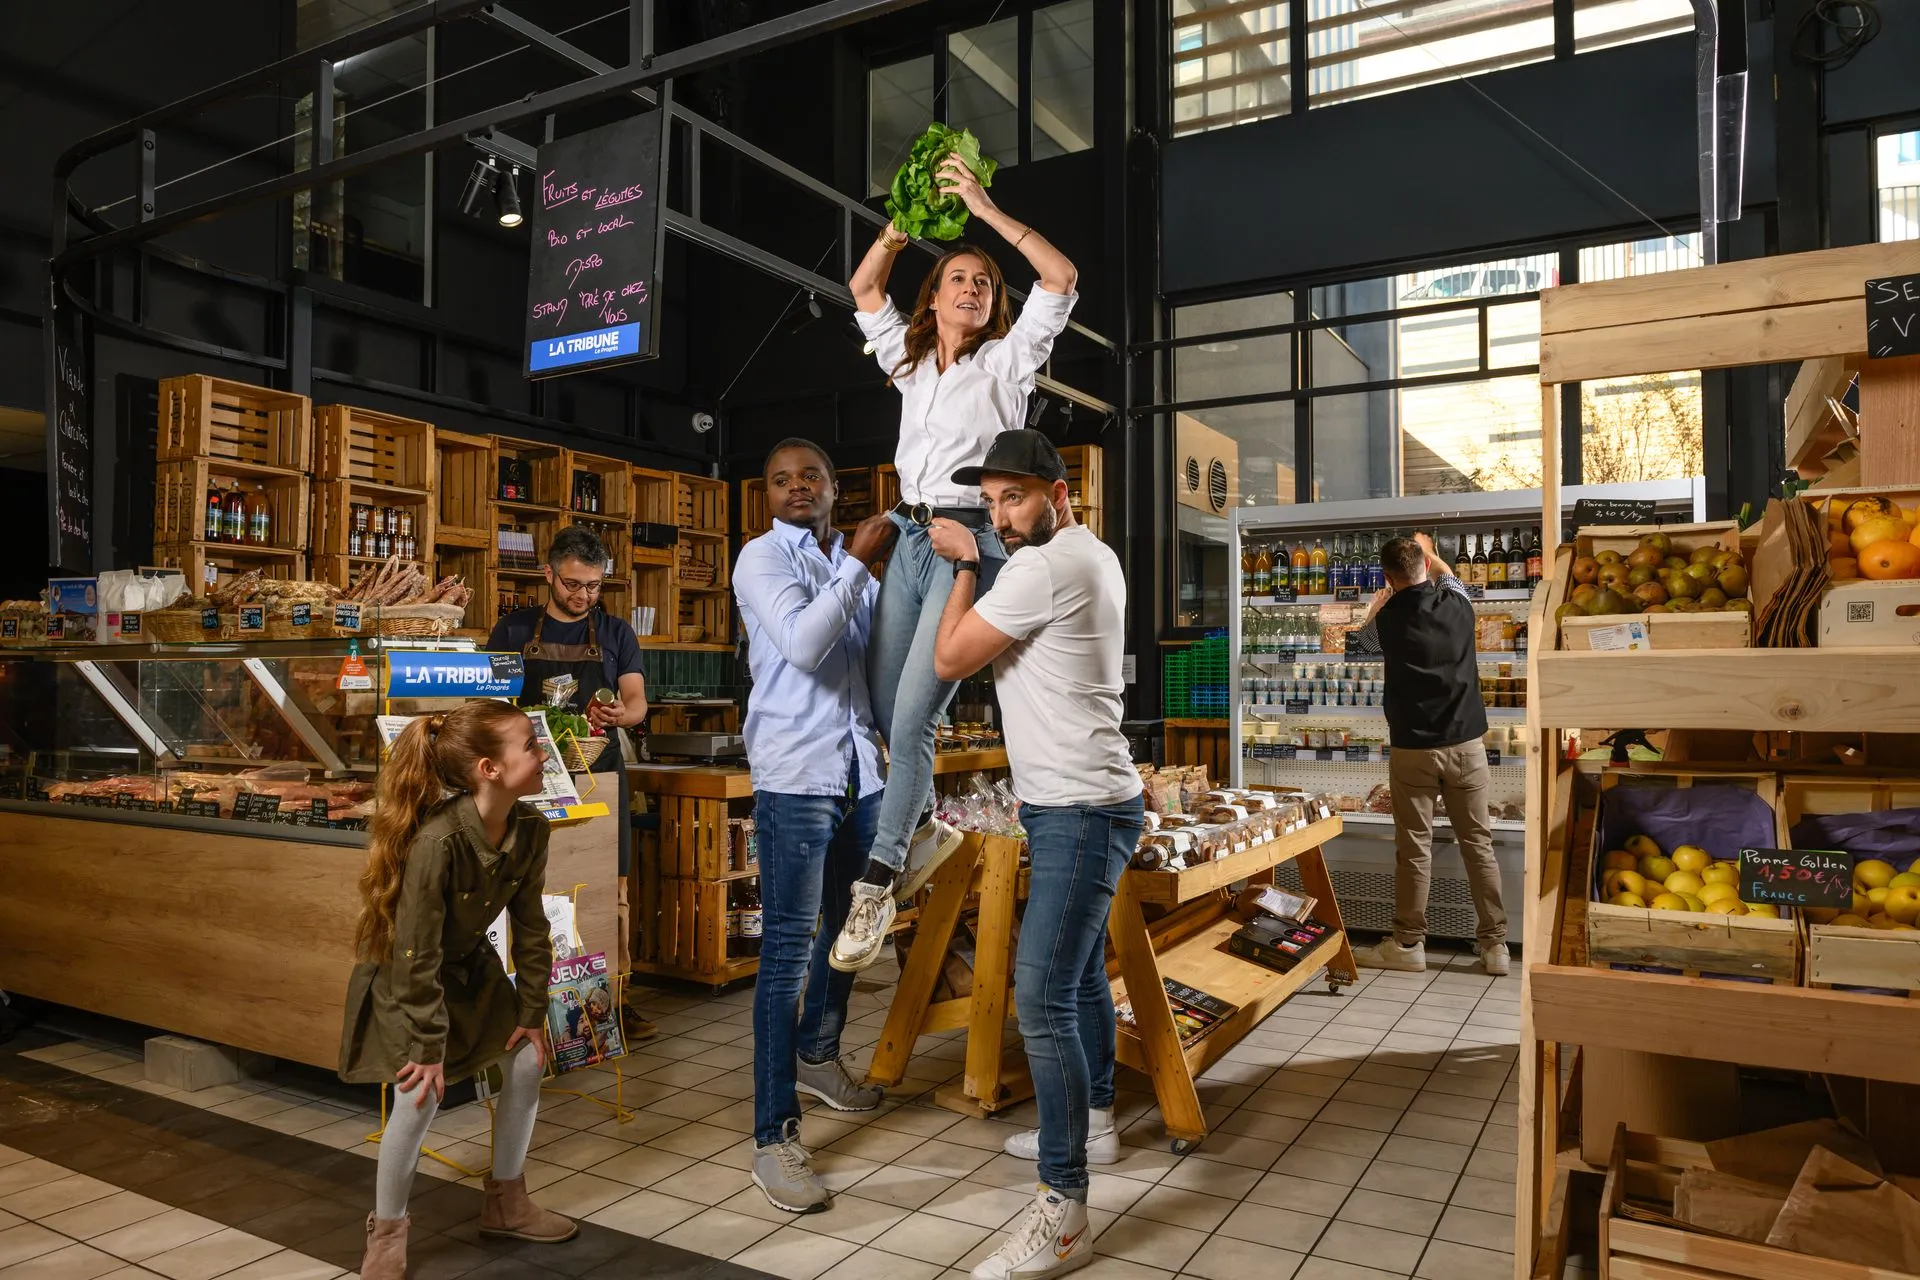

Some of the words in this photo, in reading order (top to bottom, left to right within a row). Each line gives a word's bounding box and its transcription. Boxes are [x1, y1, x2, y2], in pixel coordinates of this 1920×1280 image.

[598, 215, 634, 234] LOCAL
[549, 342, 565, 357] LA
[567, 331, 619, 353] TRIBUNE
[594, 347, 602, 355] Le
[405, 666, 431, 684] LA
[485, 684, 509, 692] Progrès
[1800, 855, 1847, 871] Golden
[551, 961, 591, 984] JEUX
